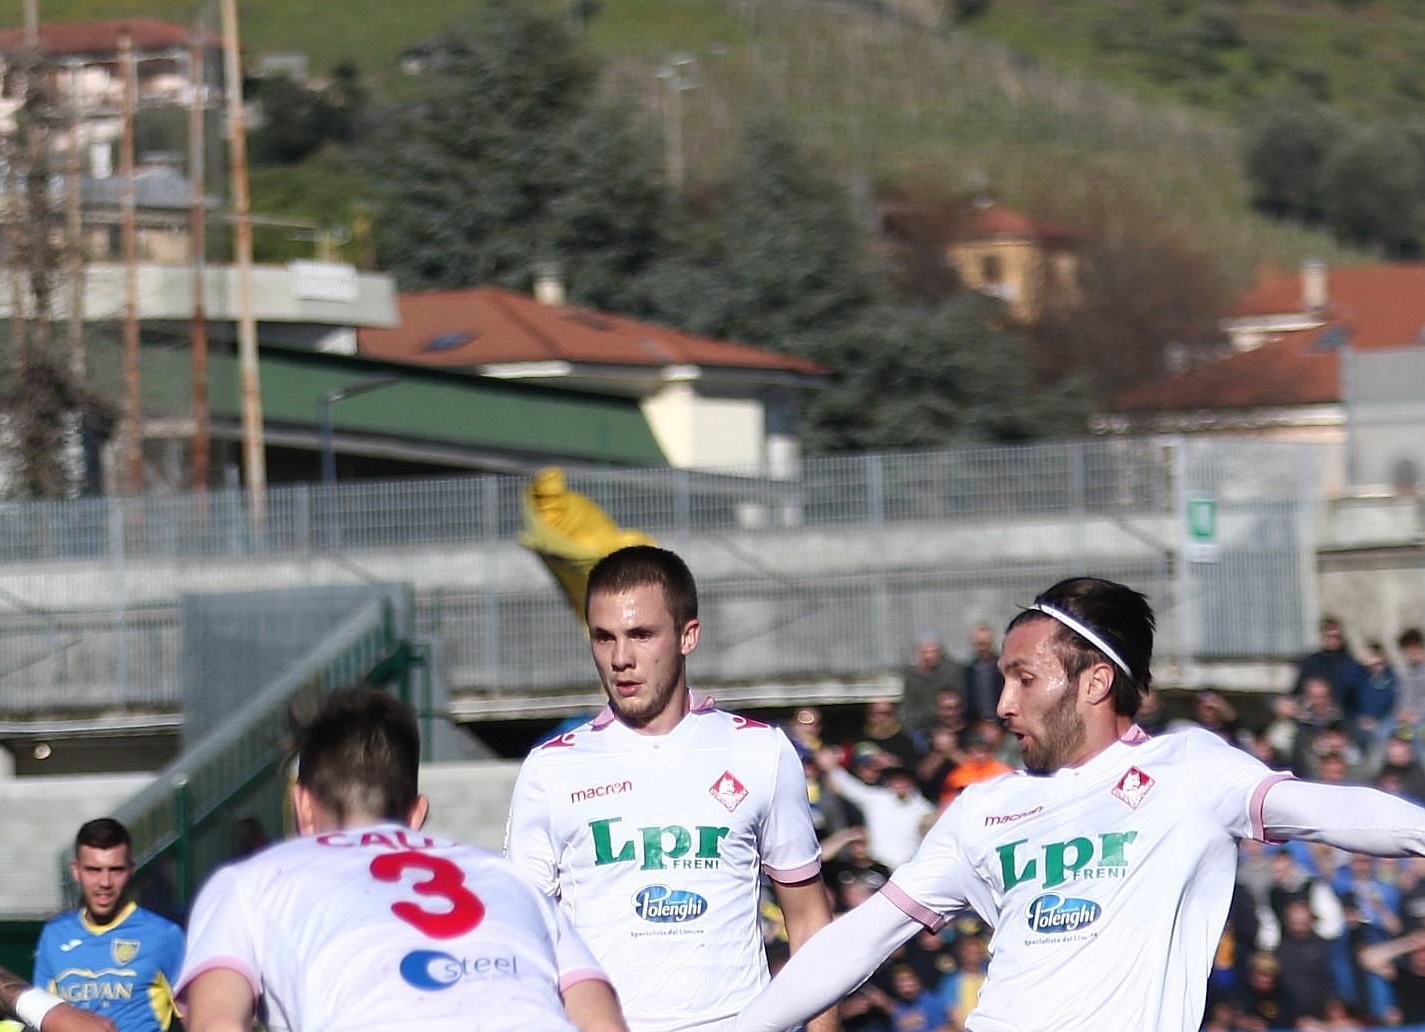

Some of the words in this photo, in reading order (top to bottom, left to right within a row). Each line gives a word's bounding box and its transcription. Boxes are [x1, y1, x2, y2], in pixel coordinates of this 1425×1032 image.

[571, 779, 633, 804] macron
[984, 805, 1044, 827] macron
[588, 816, 730, 871] Lpr
[673, 858, 719, 870] FRENI
[995, 830, 1139, 893] Lpr
[1073, 868, 1126, 881] FRENI
[369, 851, 486, 940] 3
[631, 884, 702, 922] Polenghi
[1025, 892, 1096, 931] Polenghi
[444, 955, 518, 979] steel
